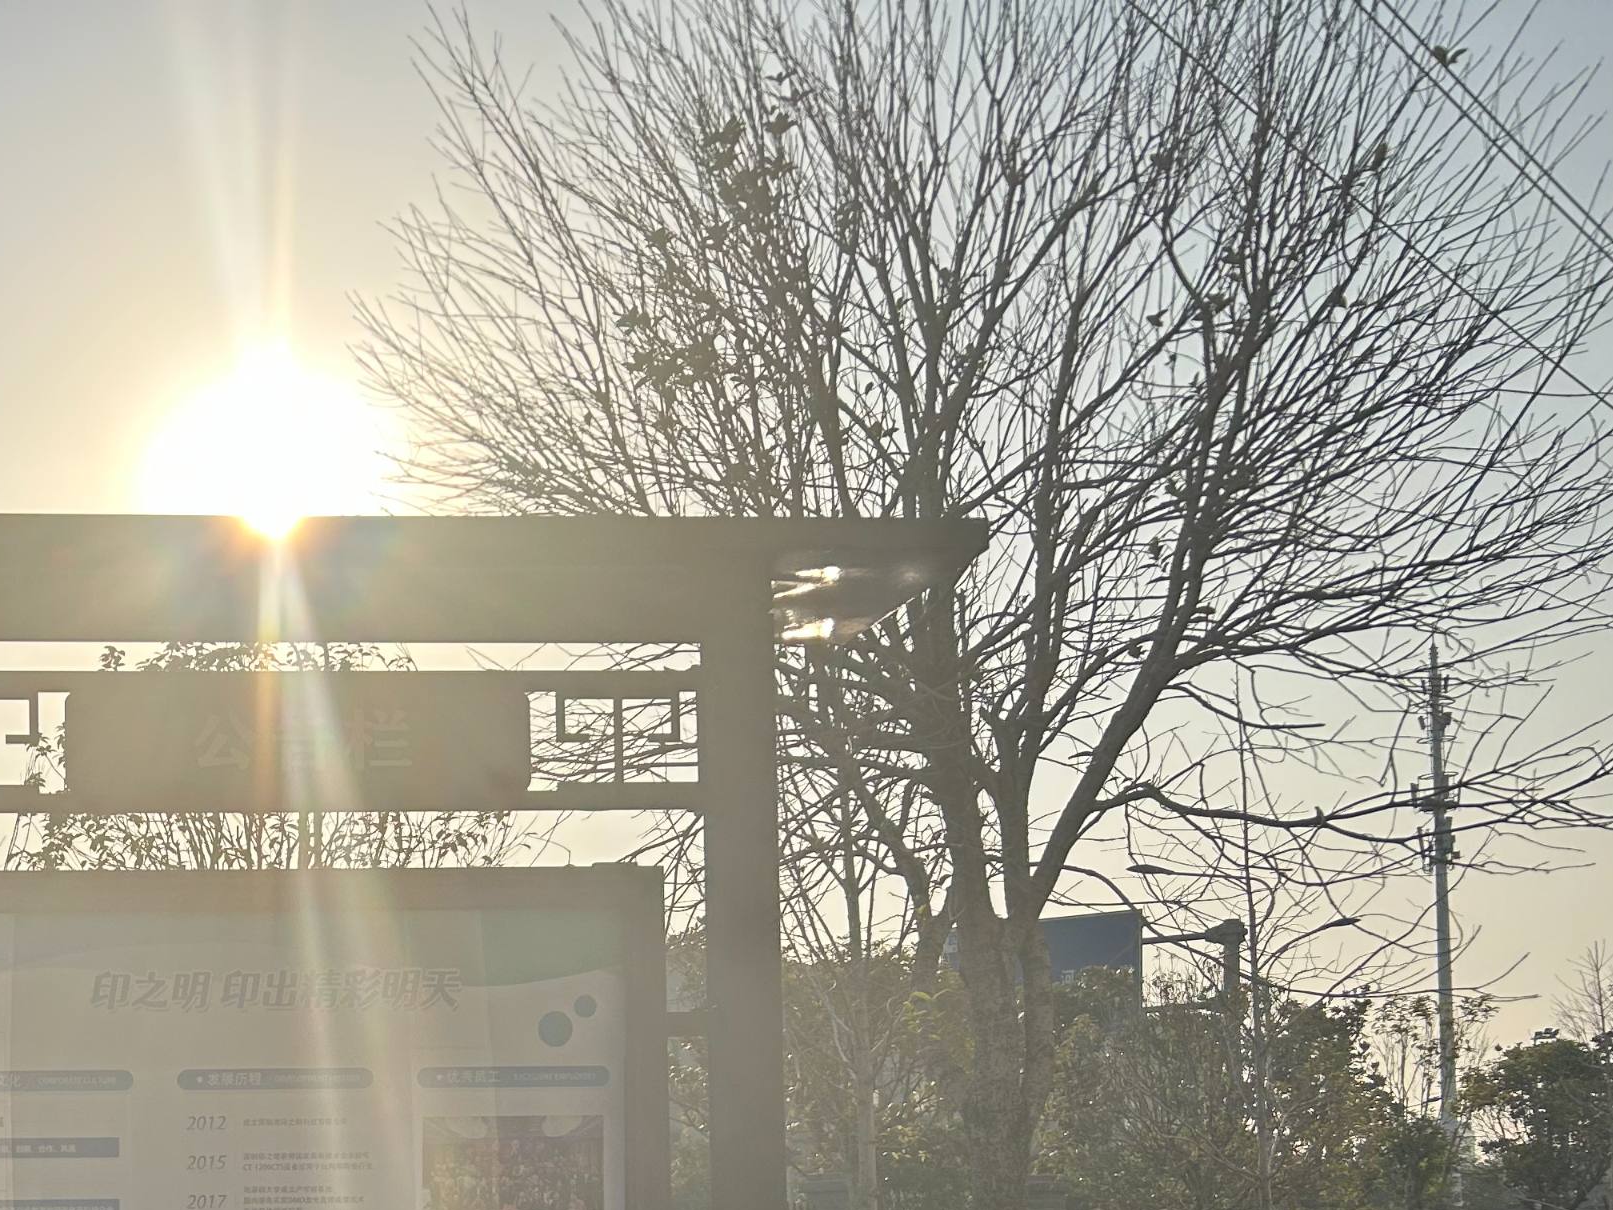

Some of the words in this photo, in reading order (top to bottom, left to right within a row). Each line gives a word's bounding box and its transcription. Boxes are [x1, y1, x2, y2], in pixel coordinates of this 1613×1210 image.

[89, 969, 212, 1013] 印之明
[219, 967, 464, 1013] 印出精彩明天
[207, 1072, 262, 1086] 发展历程
[186, 1115, 227, 1131] 2012
[186, 1154, 227, 1170] 2015
[186, 1194, 227, 1210] 2017
